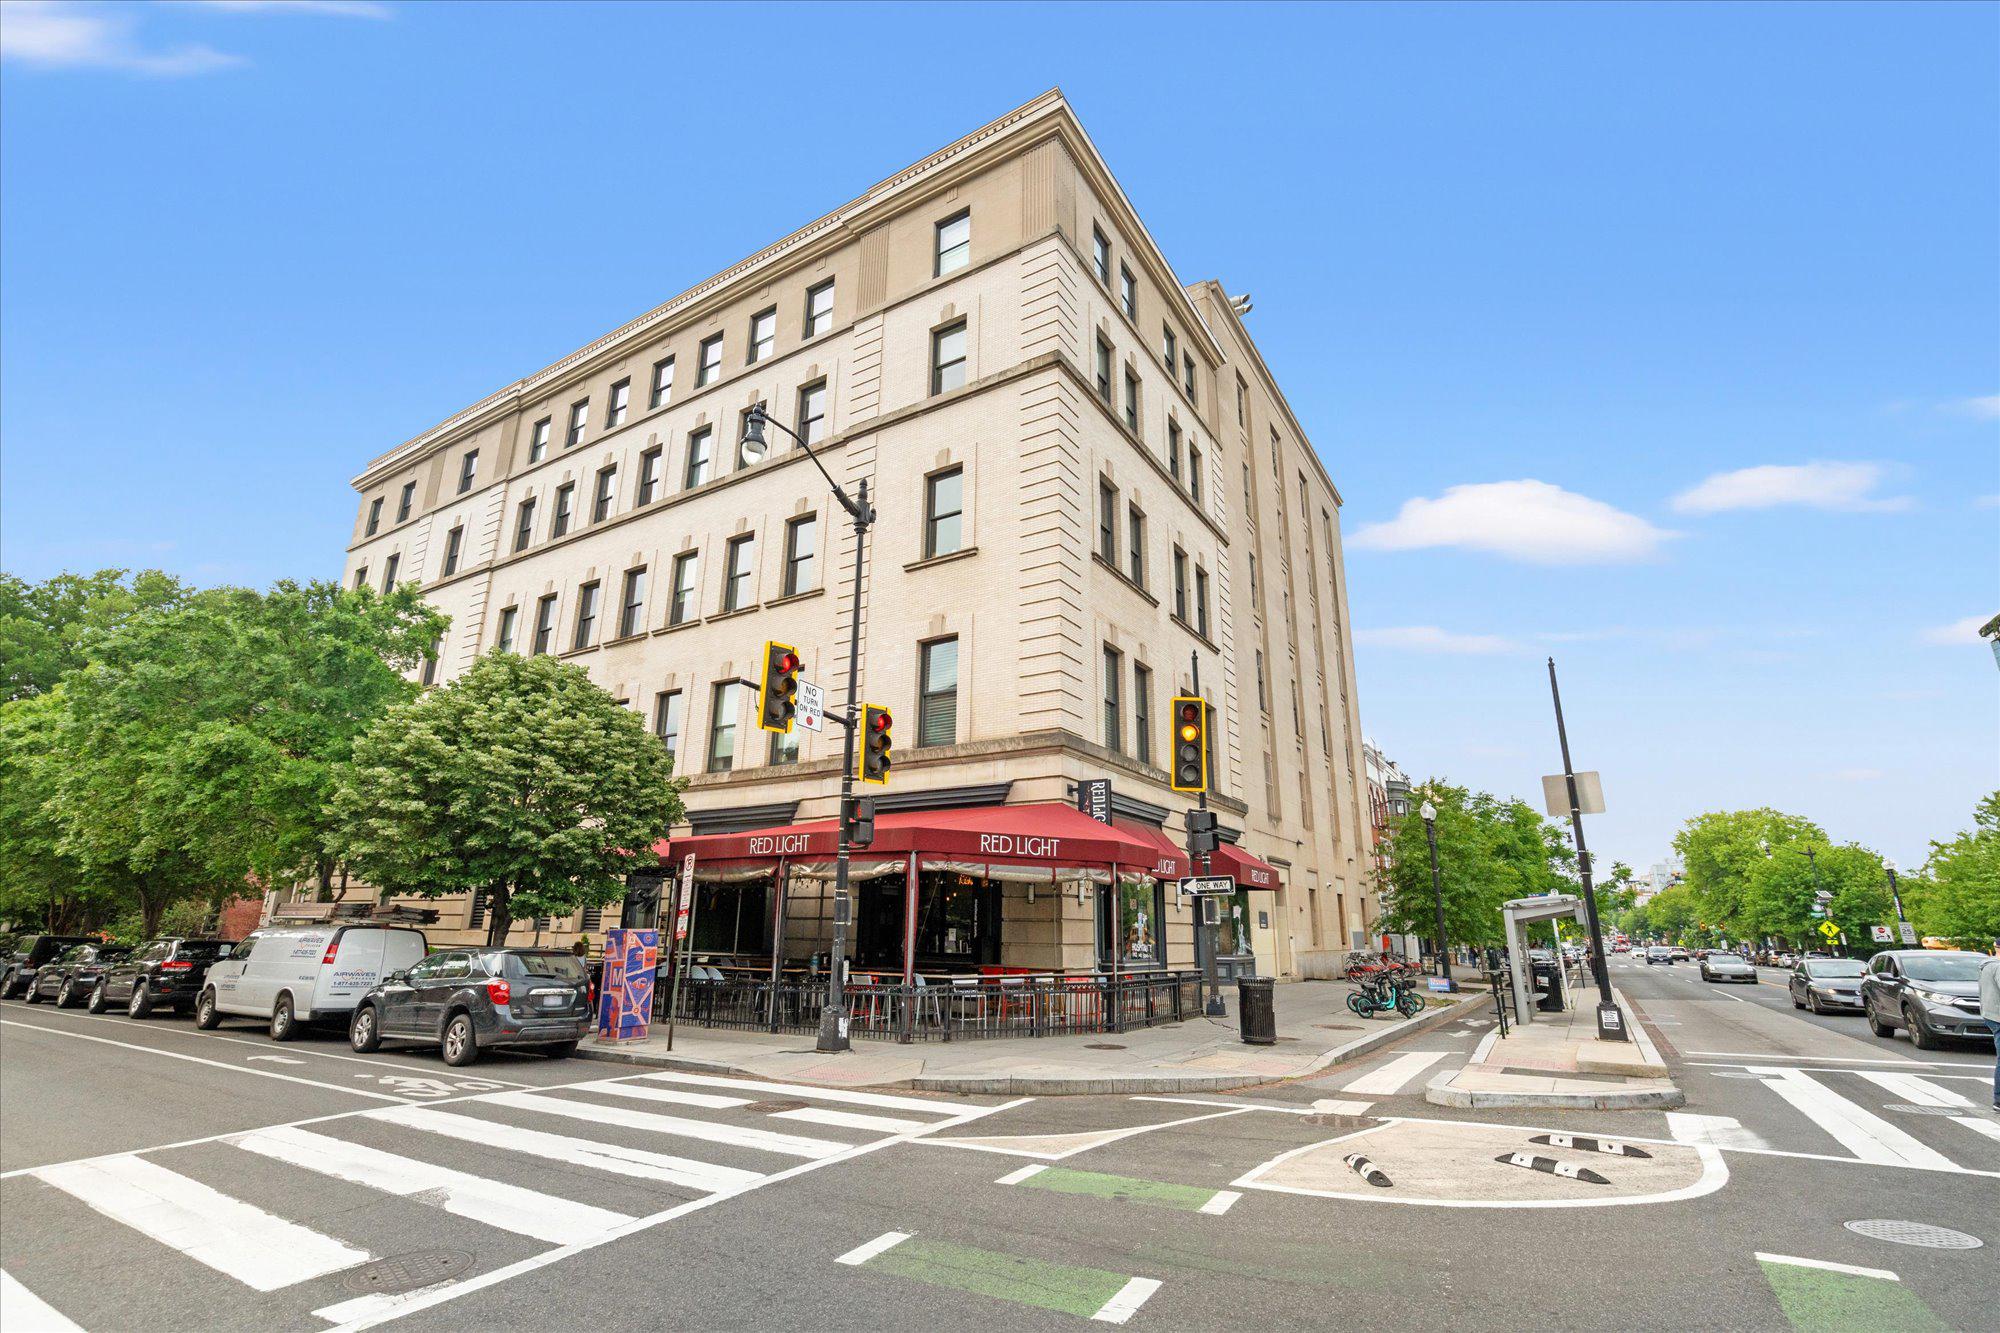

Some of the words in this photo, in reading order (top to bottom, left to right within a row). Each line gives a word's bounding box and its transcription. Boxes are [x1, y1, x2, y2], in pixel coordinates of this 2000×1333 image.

[805, 686, 817, 697] NO
[803, 695, 819, 707] TURN
[800, 703, 808, 712] ON
[809, 707, 820, 717] RED
[1090, 782, 1106, 803] RED
[750, 837, 773, 854] RED
[775, 834, 810, 853] LIGHT
[980, 834, 1013, 853] RED
[1016, 836, 1060, 857] LIGHT
[1160, 858, 1176, 874] LIGHT
[1196, 882, 1211, 890] ONE
[1213, 881, 1228, 889] WAY
